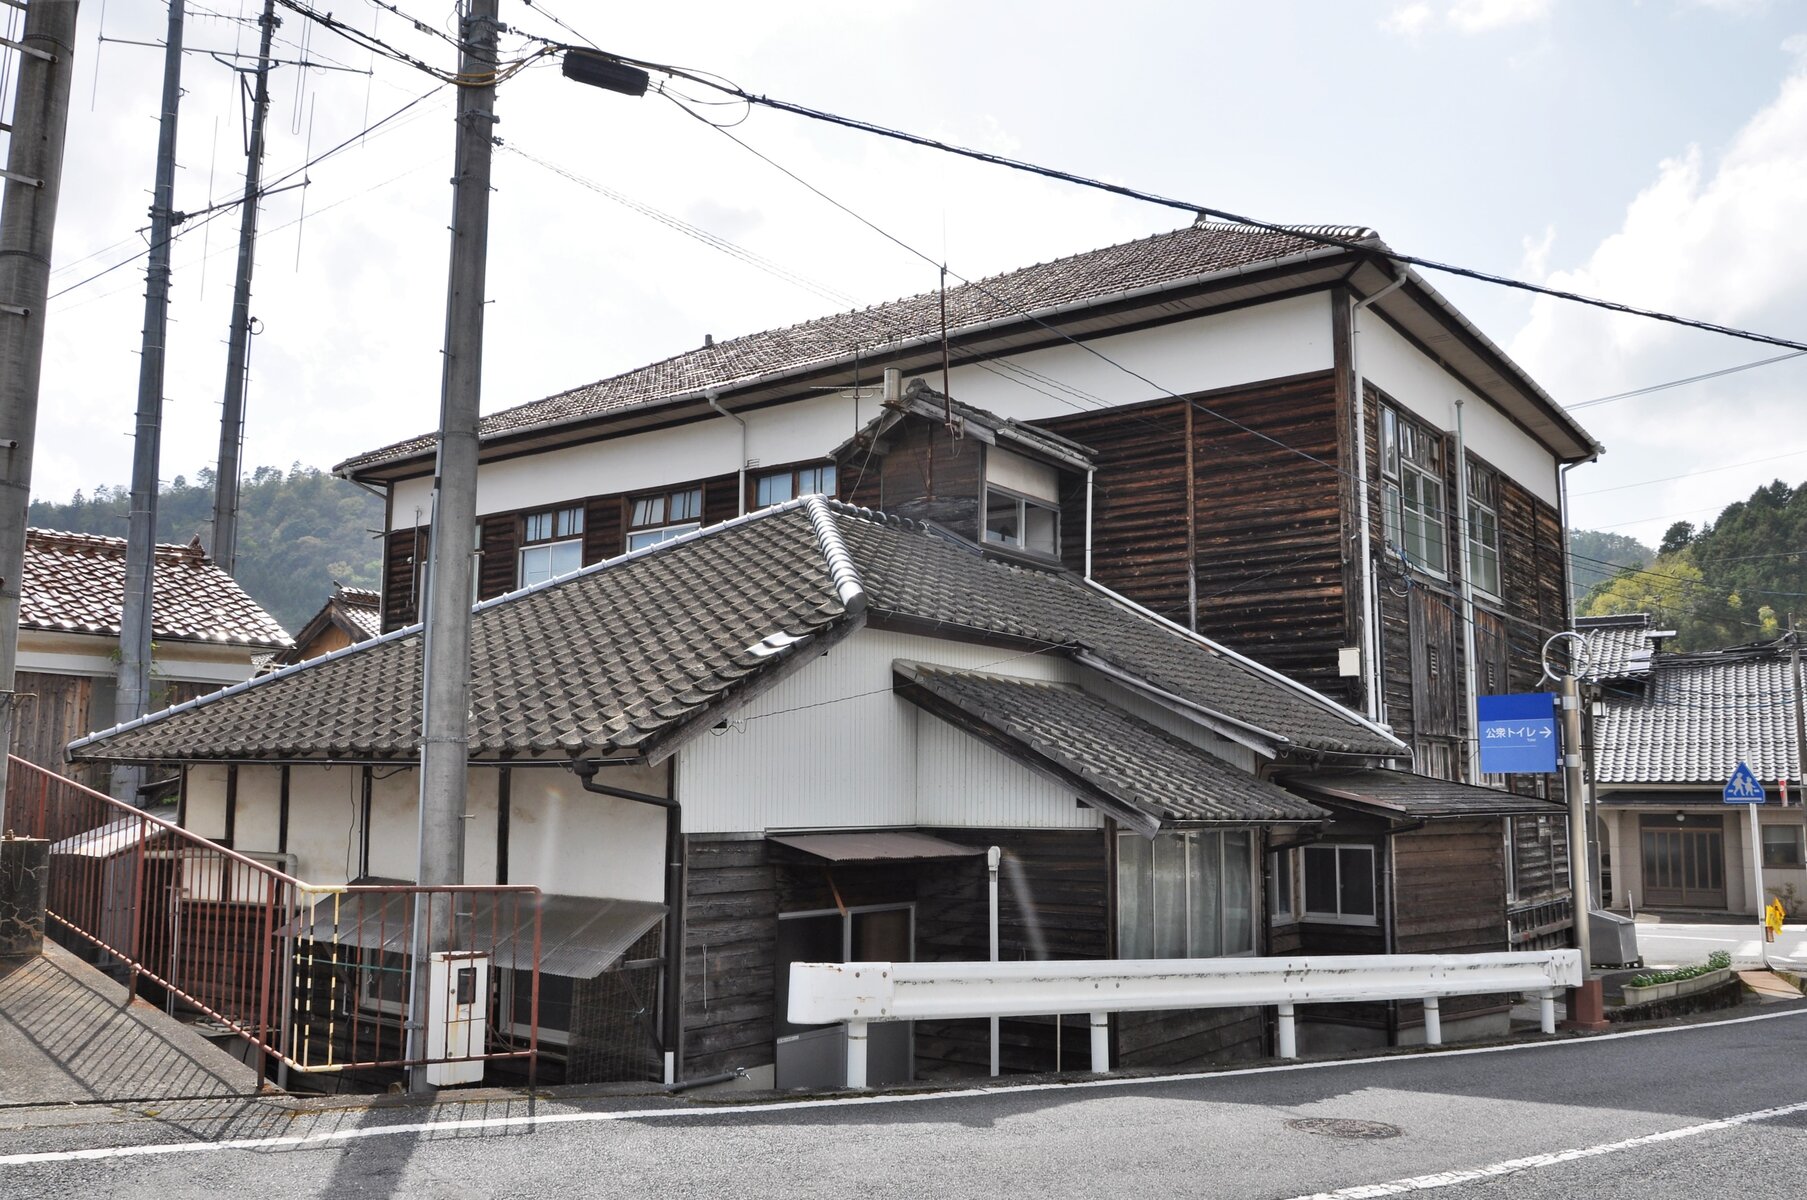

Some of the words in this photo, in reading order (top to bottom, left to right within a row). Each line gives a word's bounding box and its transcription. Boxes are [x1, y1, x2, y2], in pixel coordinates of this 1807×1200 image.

[1486, 727, 1536, 738] 公衆トイレ
